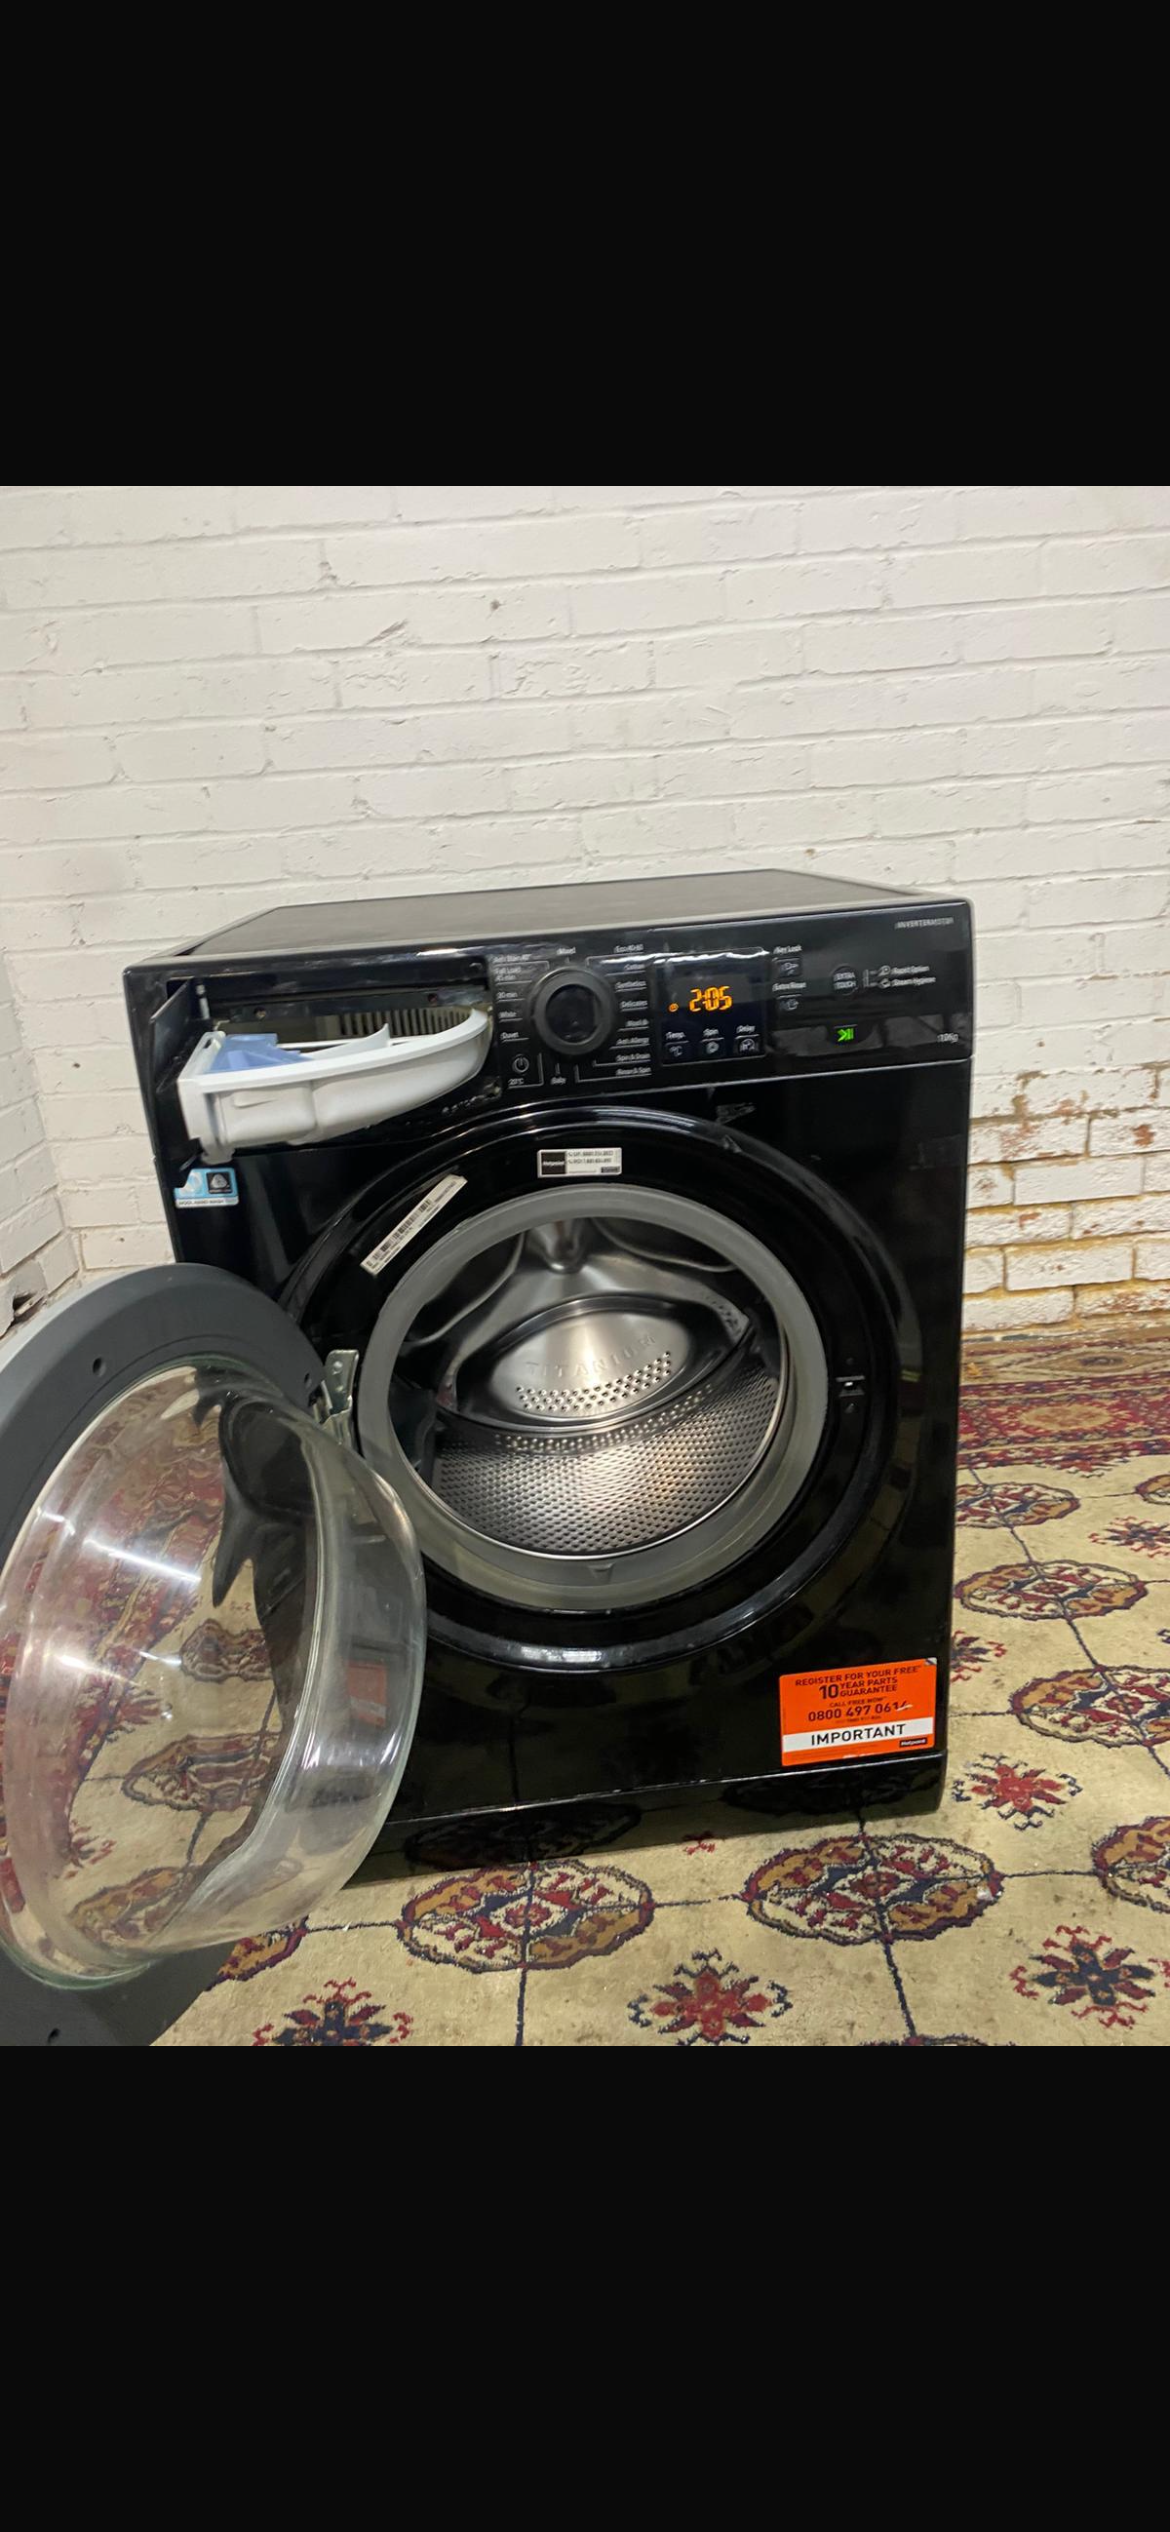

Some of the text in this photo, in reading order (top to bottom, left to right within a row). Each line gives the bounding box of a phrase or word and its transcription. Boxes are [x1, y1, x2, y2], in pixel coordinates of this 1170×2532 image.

[788, 944, 802, 953] Lock
[689, 985, 733, 1012] 2:05
[795, 1673, 842, 1686] REGISTER
[844, 1671, 864, 1681] FOR
[866, 1667, 891, 1678] YOUR
[819, 1676, 898, 1700] 10 YEAR PARTS
[840, 1684, 898, 1697] GUARANTEE
[848, 1697, 865, 1705] FREE
[808, 1708, 842, 1722] 0800
[845, 1704, 871, 1717] 497
[812, 1723, 906, 1746] IMPORTANT
